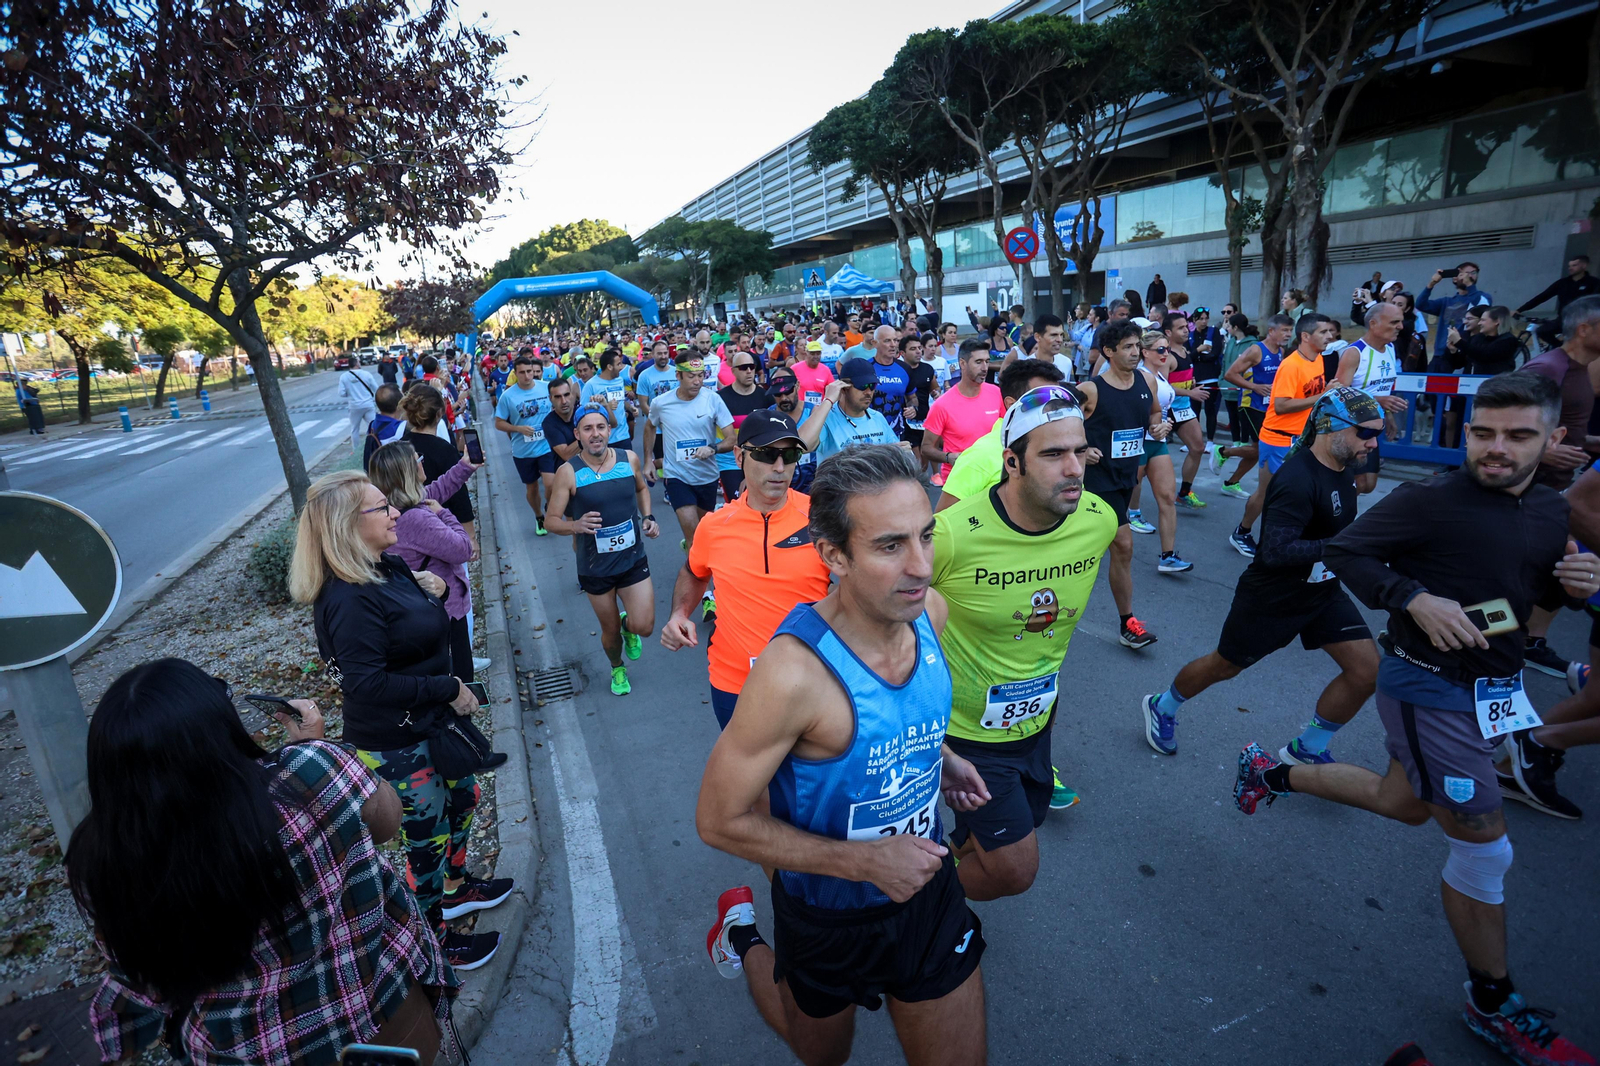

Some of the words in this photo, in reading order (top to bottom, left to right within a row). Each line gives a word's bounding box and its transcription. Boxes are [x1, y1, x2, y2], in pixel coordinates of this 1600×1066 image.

[1178, 410, 1190, 418] 722
[1121, 440, 1139, 452] 273
[610, 535, 625, 547] 56
[975, 556, 1095, 589] Paparunners
[1014, 682, 1034, 690] Carrera
[1034, 676, 1052, 685] Popular
[1005, 689, 1025, 697] Ciudad
[1002, 697, 1042, 720] 836
[870, 802, 890, 811] XLIII
[891, 787, 915, 806] Carrera
[878, 803, 907, 819] Ciudad
[907, 798, 916, 807] de
